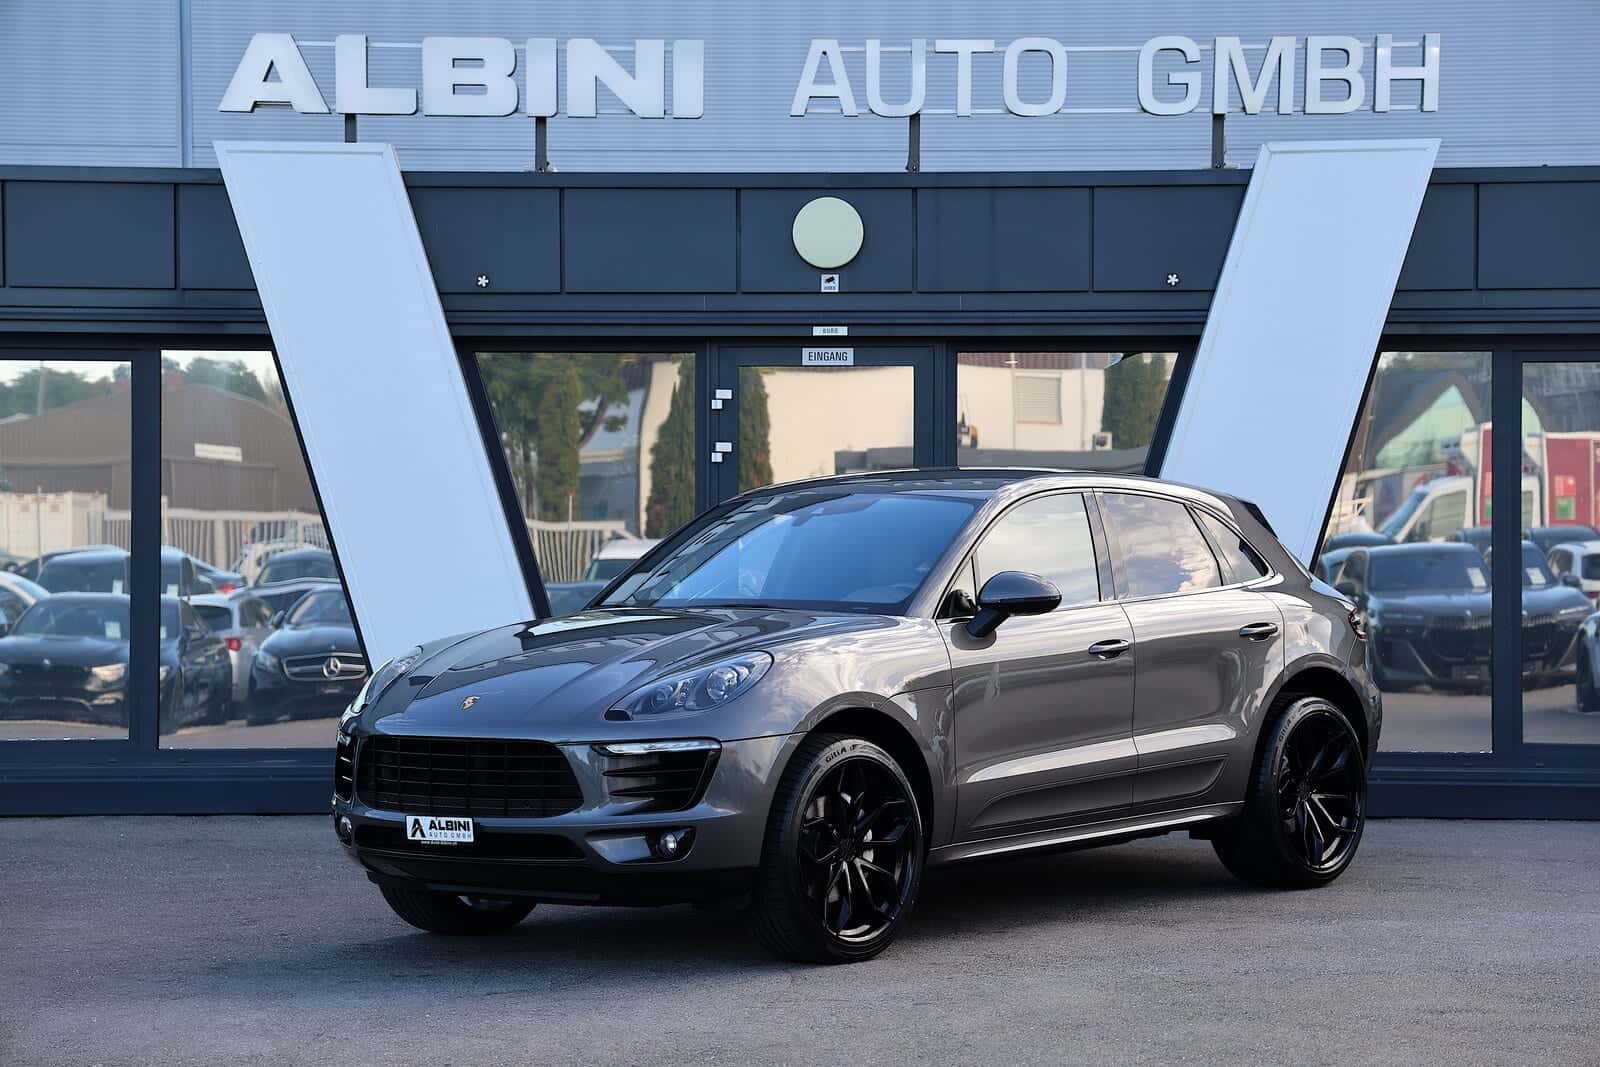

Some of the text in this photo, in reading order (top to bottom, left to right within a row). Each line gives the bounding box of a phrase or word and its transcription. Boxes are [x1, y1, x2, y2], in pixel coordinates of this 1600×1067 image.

[218, 33, 1440, 118] ALBINI AUTO GMBH
[808, 351, 848, 362] EINGANG
[429, 819, 471, 832] ALBINI
